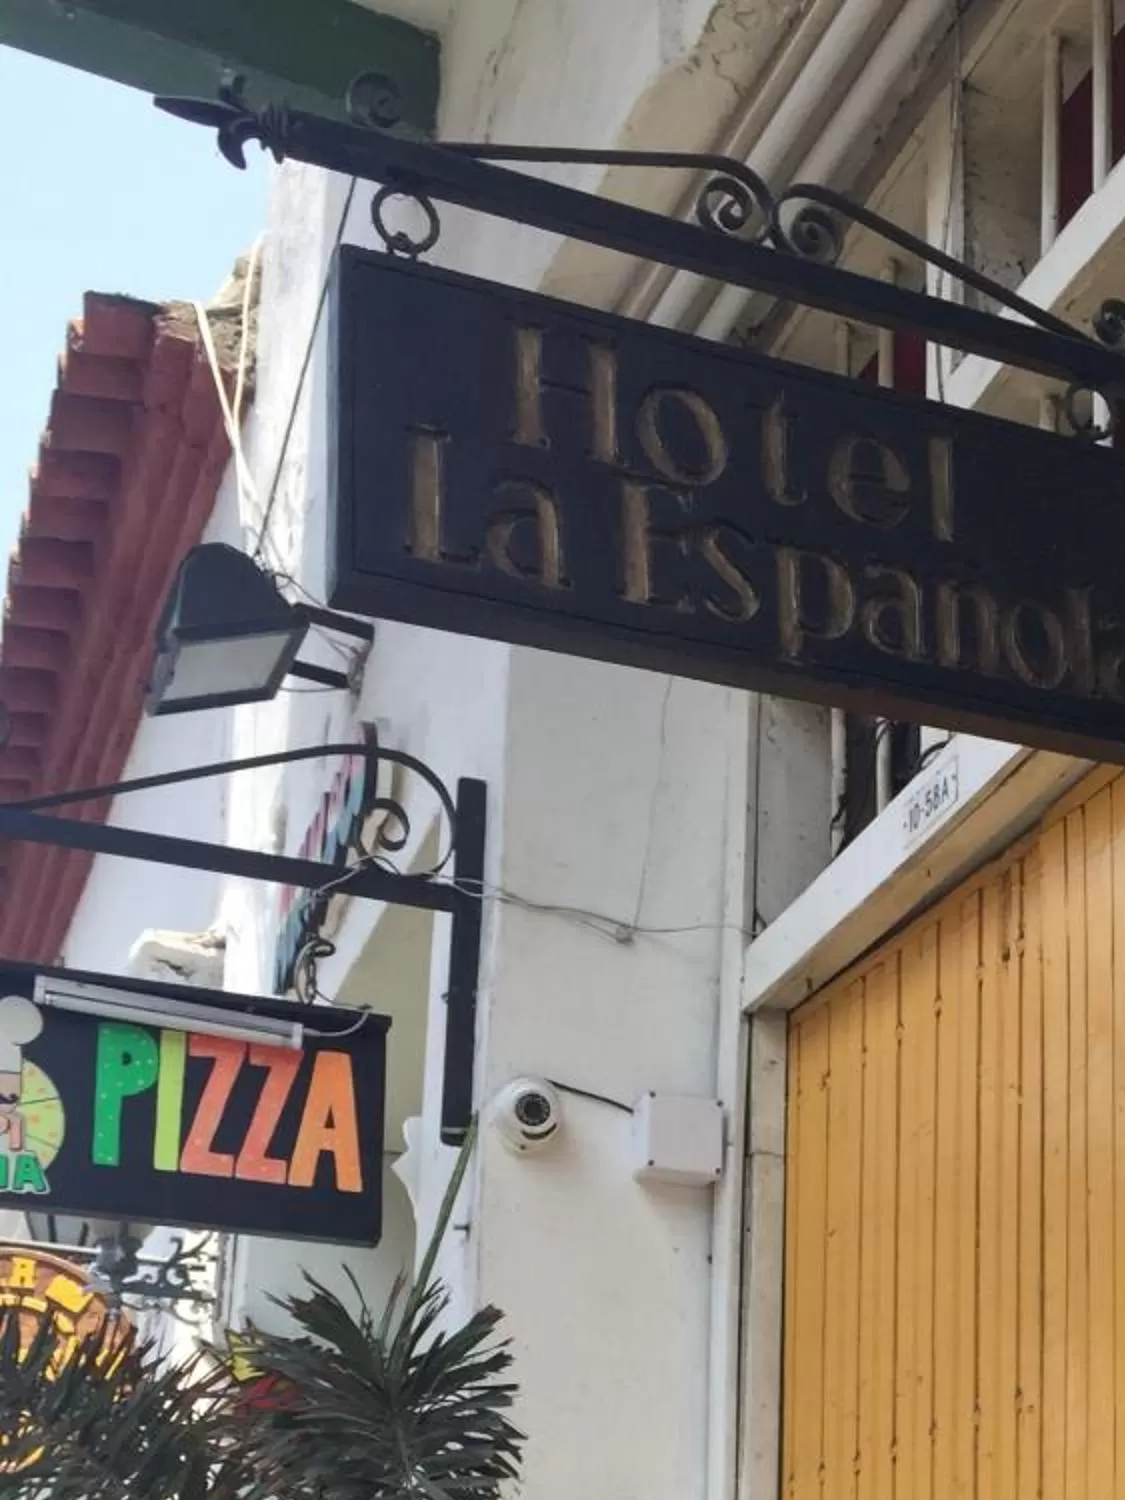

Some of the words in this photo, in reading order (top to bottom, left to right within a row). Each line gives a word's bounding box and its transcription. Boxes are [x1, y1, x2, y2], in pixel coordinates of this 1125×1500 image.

[404, 420, 576, 592] La
[503, 322, 958, 543] Hotel
[92, 1022, 363, 1193] PIZZA
